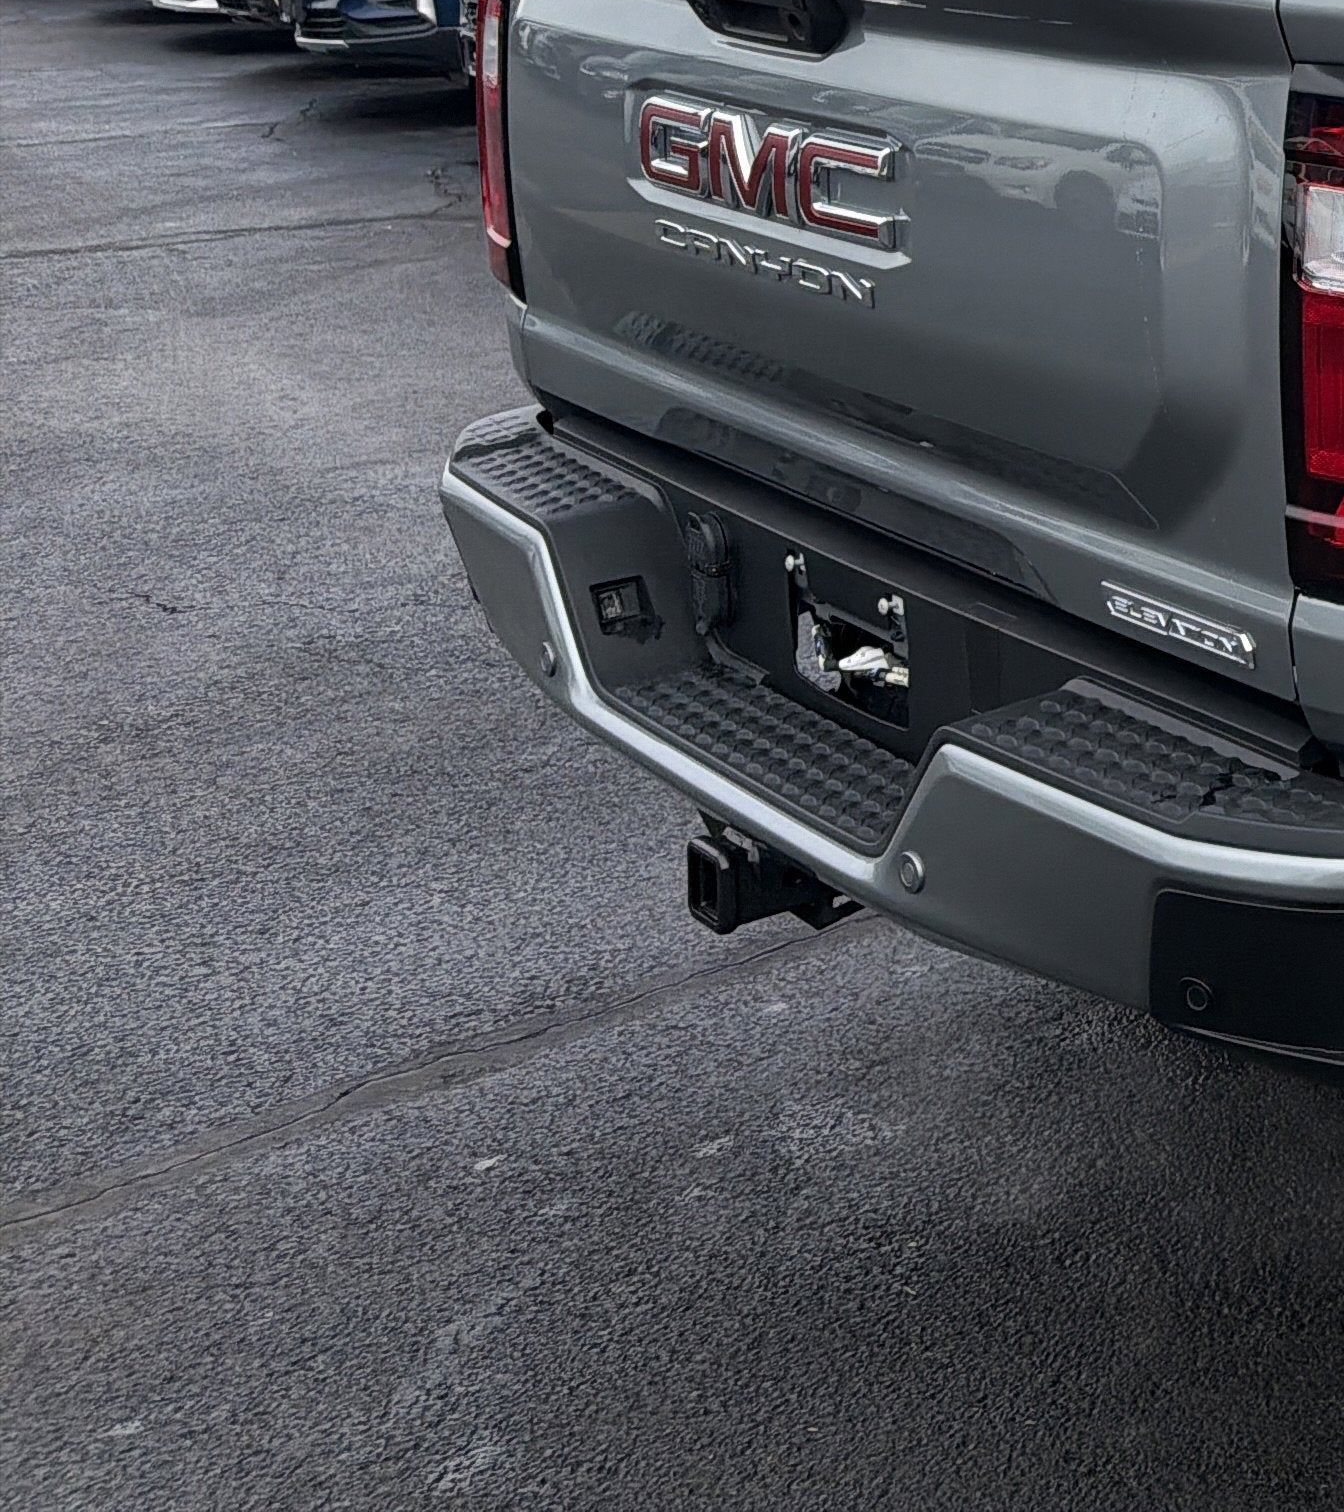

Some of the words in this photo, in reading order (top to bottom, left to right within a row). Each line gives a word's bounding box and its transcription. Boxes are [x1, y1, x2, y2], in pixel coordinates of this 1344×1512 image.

[639, 93, 902, 250] GMC
[655, 219, 876, 309] CANYON
[1106, 591, 1246, 659] ELEVATION
